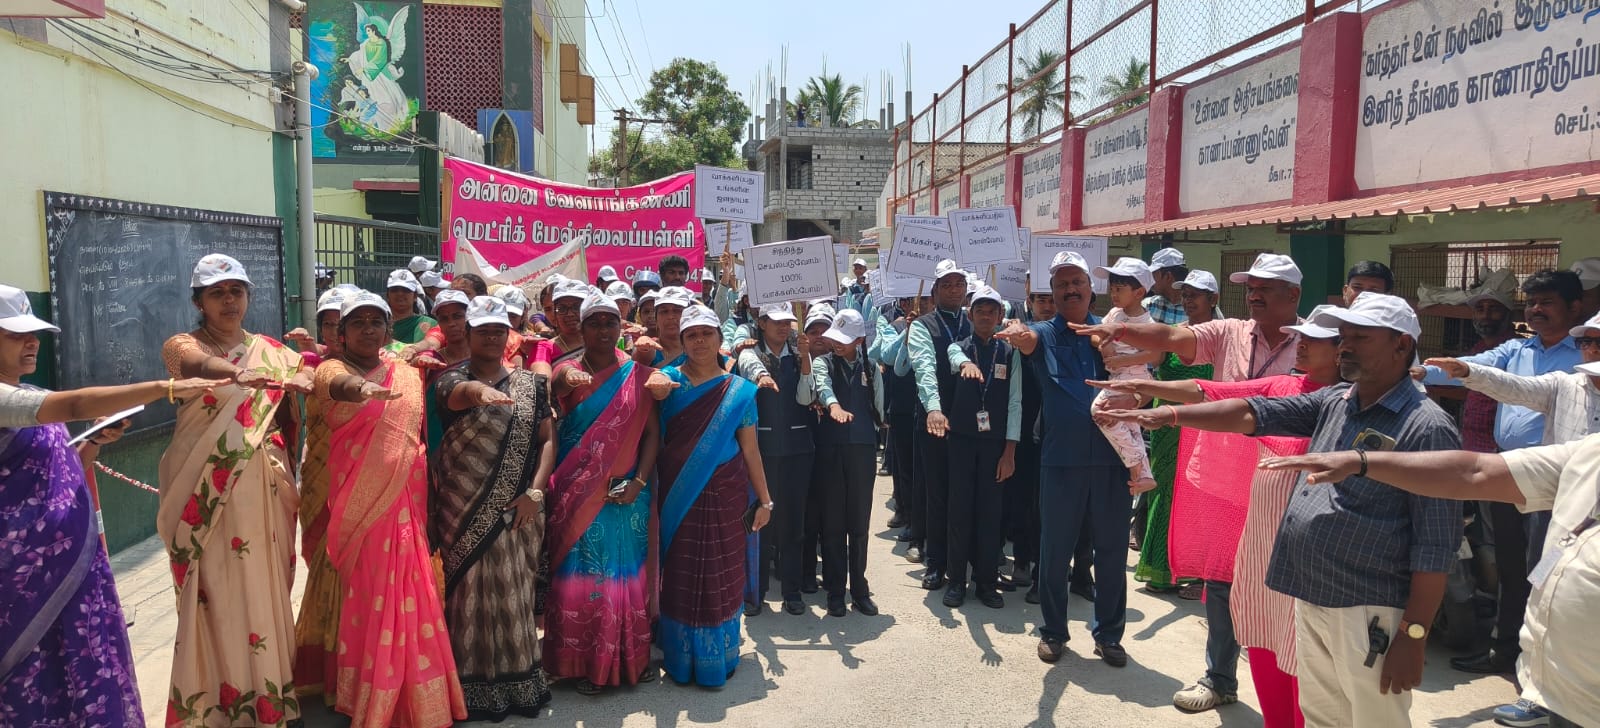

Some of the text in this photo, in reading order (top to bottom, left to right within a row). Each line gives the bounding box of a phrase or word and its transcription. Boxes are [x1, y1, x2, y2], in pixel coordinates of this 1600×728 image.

[1412, 24, 1441, 63] உன்
[1442, 1, 1503, 65] நடுவில்
[1362, 38, 1600, 129] இனித் தீங்கை காணாதிருப்ப
[460, 174, 691, 212] அன்னை வேளாங்கண்ணி
[453, 215, 695, 248] மெட்ரிக் மேல்நிலைப்பள்ளி
